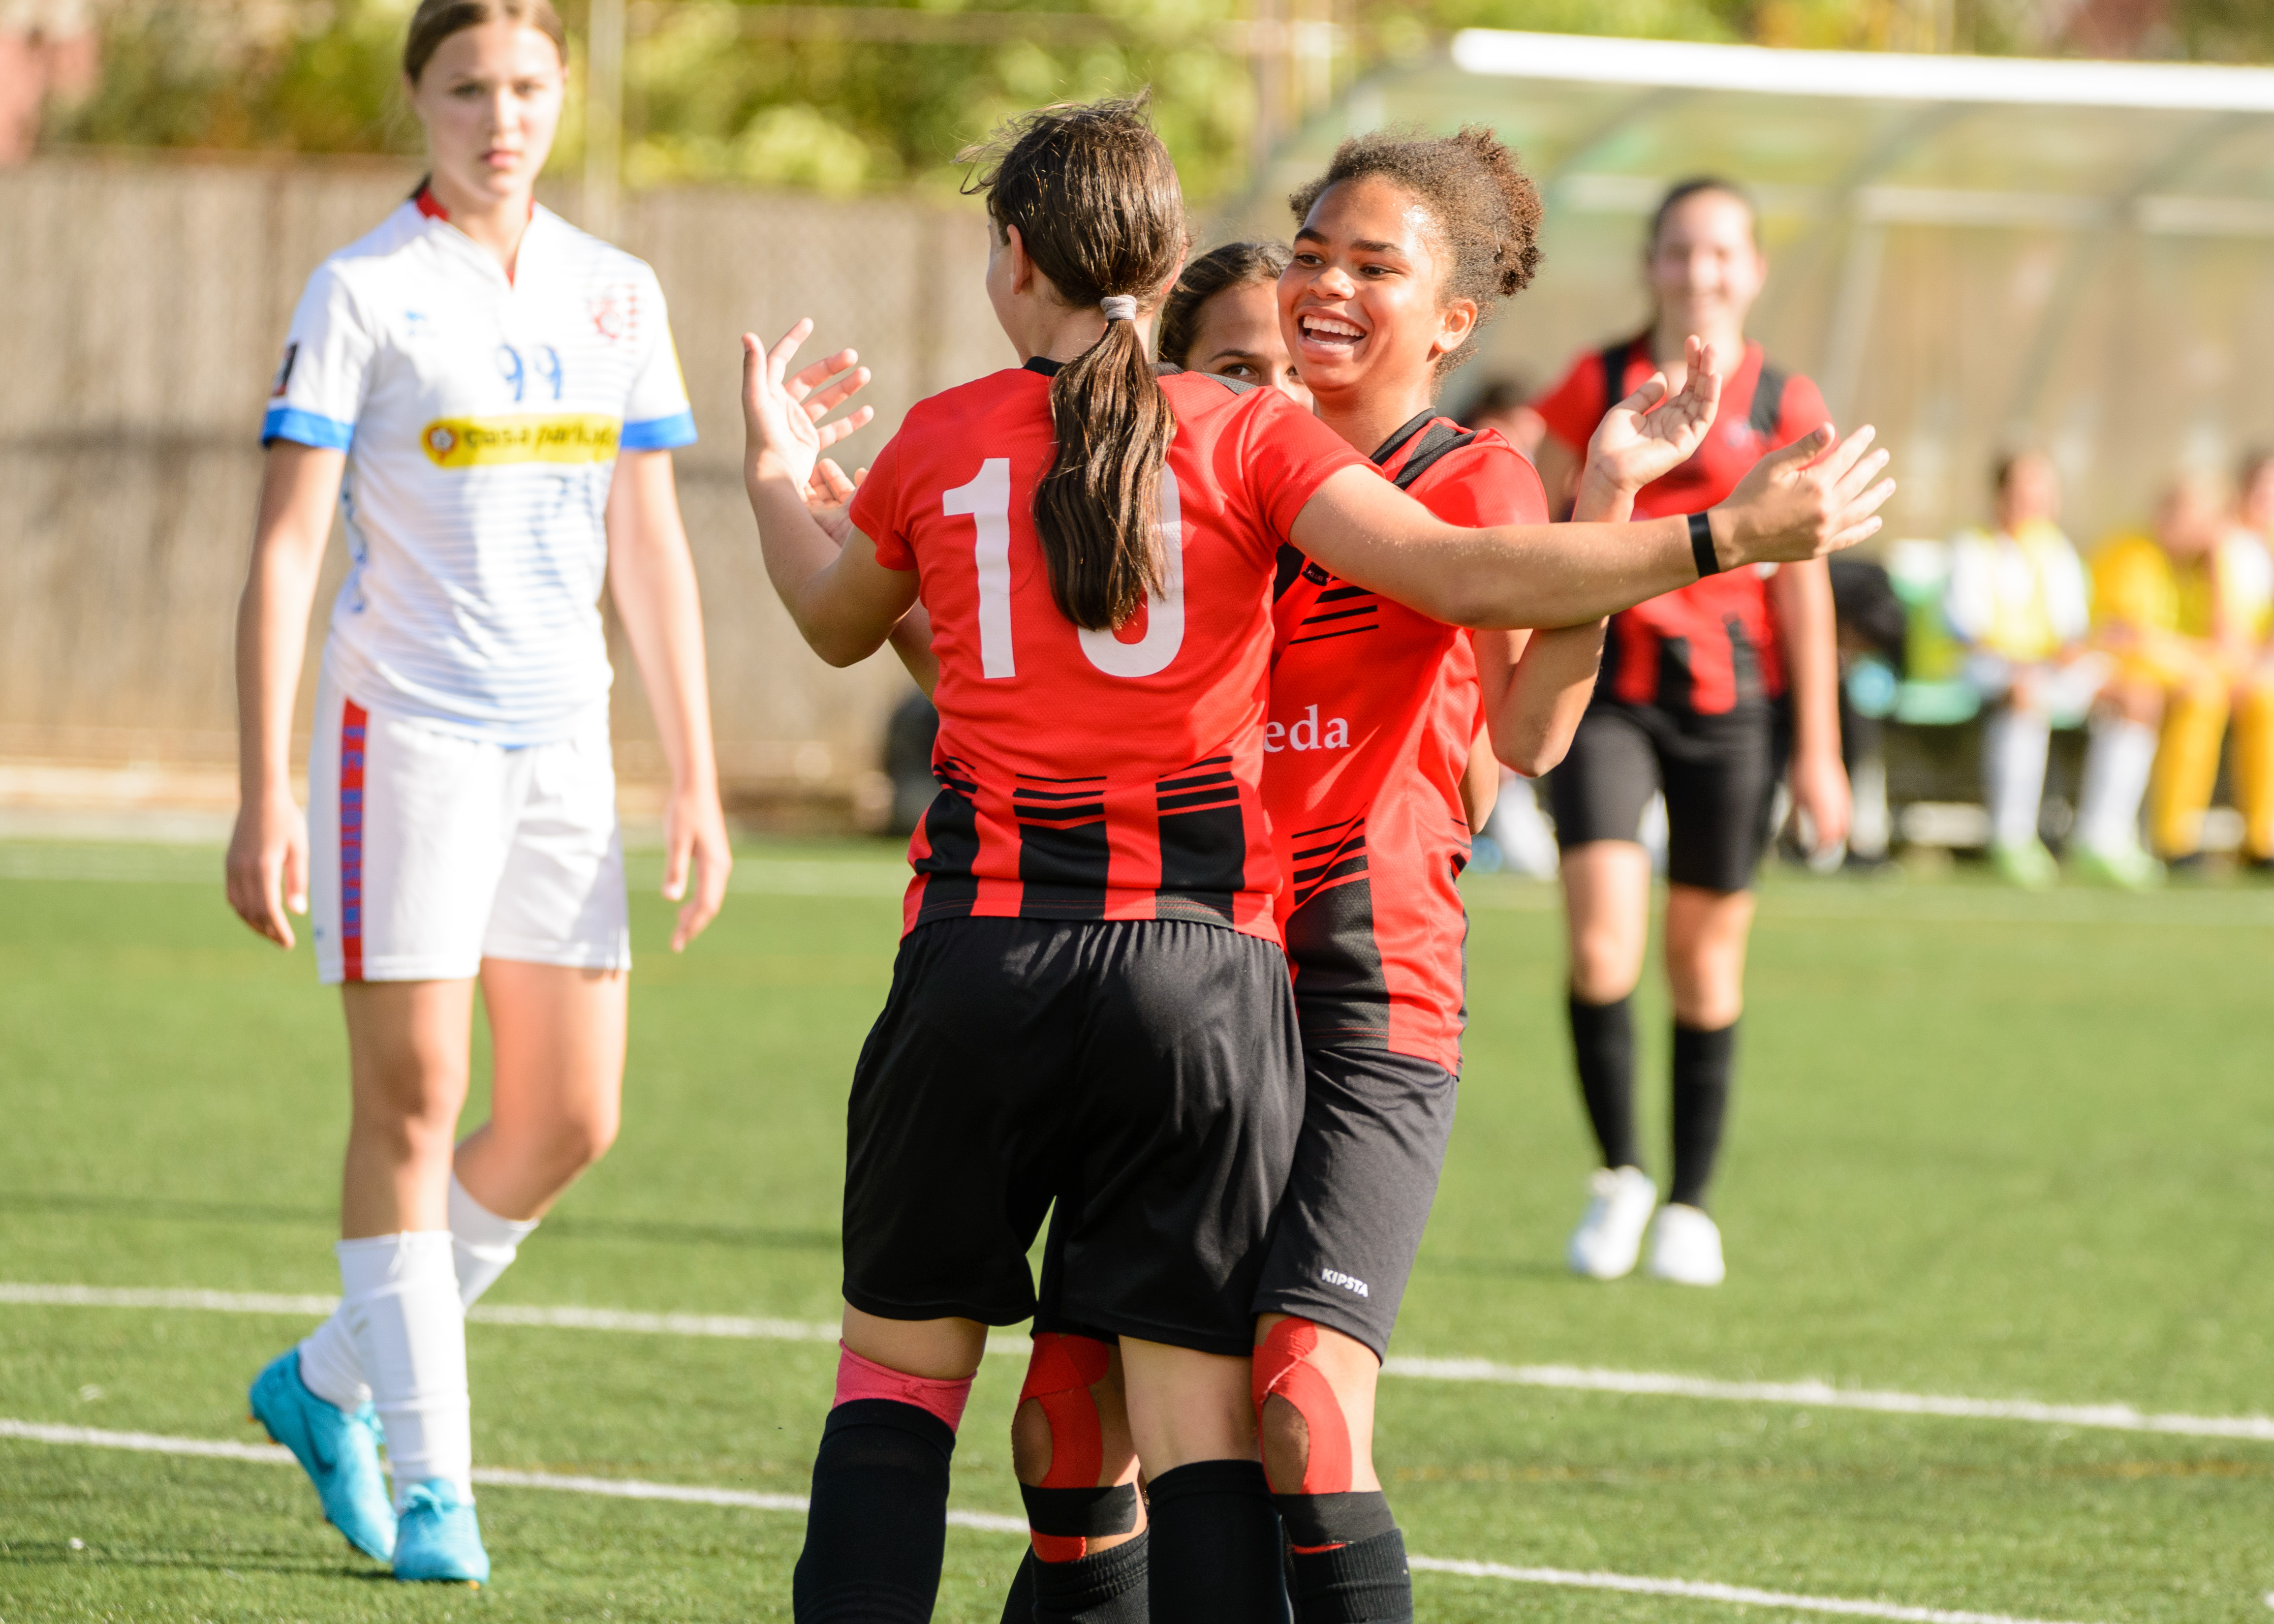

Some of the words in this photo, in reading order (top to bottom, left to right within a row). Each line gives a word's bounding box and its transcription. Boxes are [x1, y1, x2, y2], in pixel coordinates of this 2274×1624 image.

[495, 343, 561, 401] 99
[1307, 570, 1324, 581] KLUB
[1321, 1268, 1369, 1298] KIPSTA
